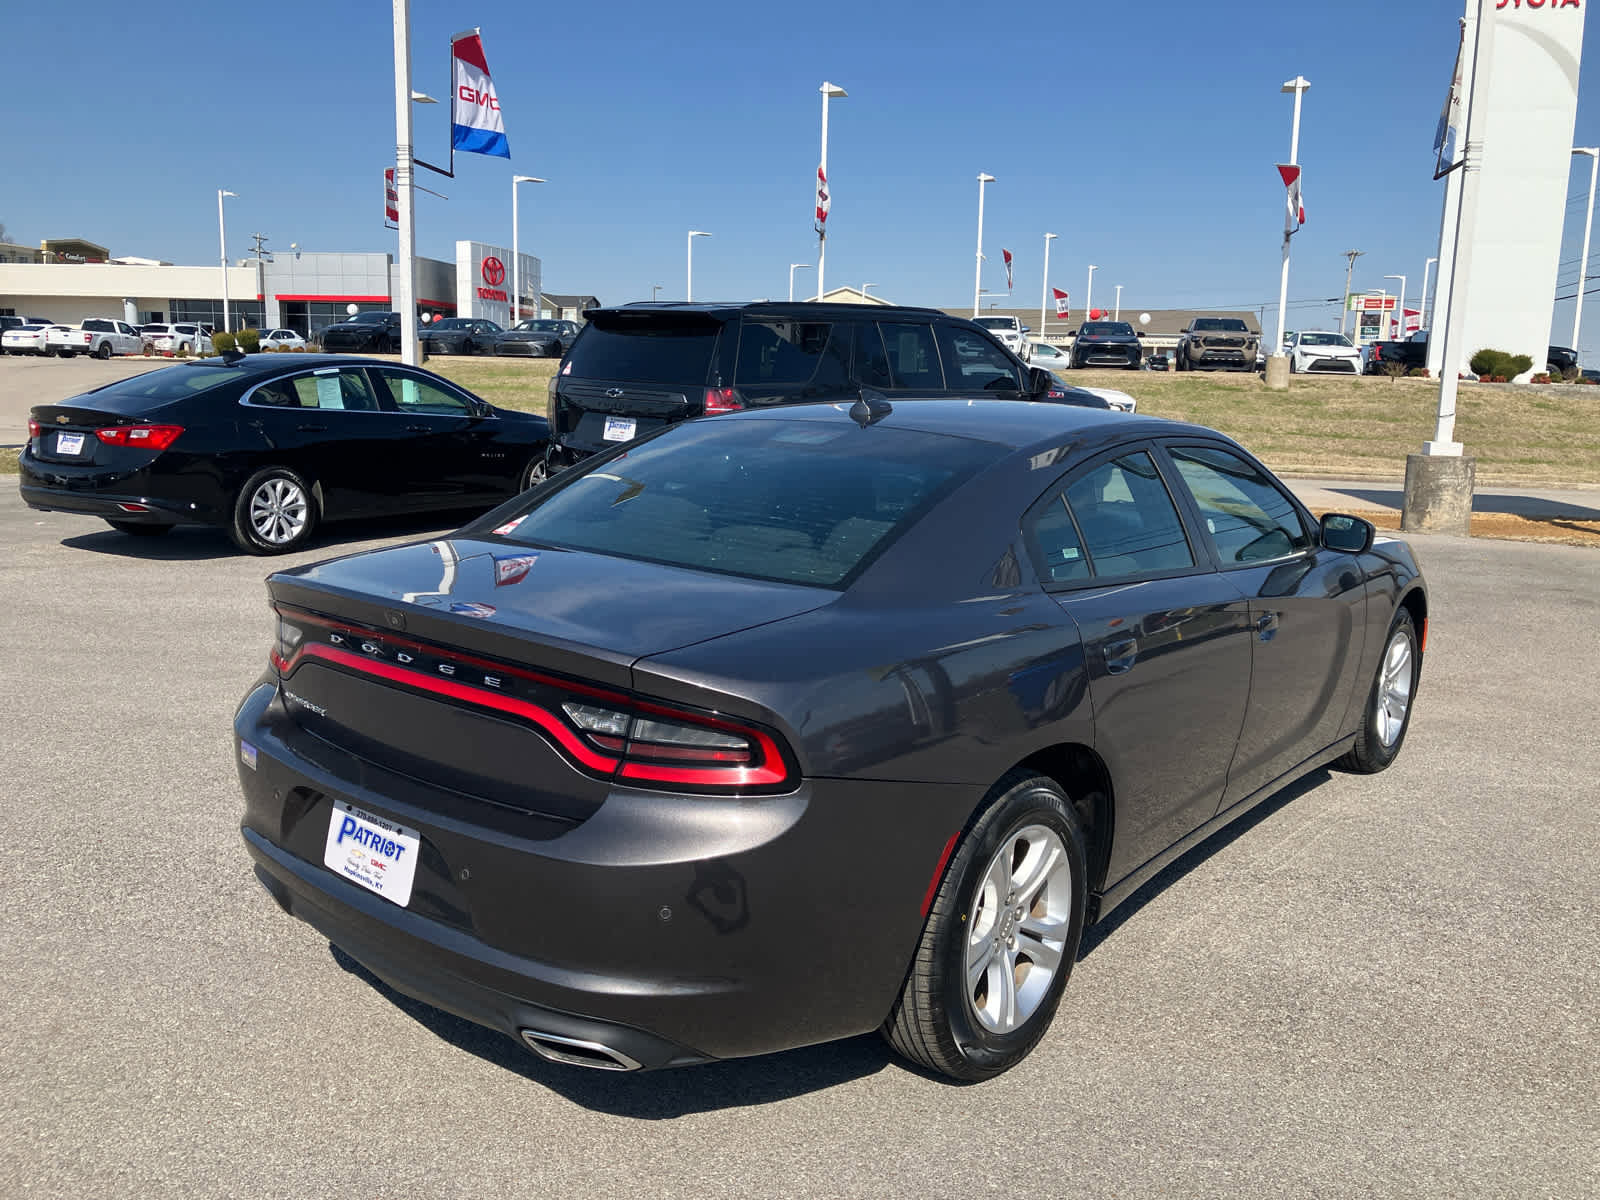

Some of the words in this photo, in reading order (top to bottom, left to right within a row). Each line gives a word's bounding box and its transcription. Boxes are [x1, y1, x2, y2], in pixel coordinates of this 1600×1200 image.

[459, 86, 501, 111] GMC
[477, 287, 508, 303] TOYOTA
[330, 632, 501, 688] DODGE
[337, 815, 406, 861] PATRIOT
